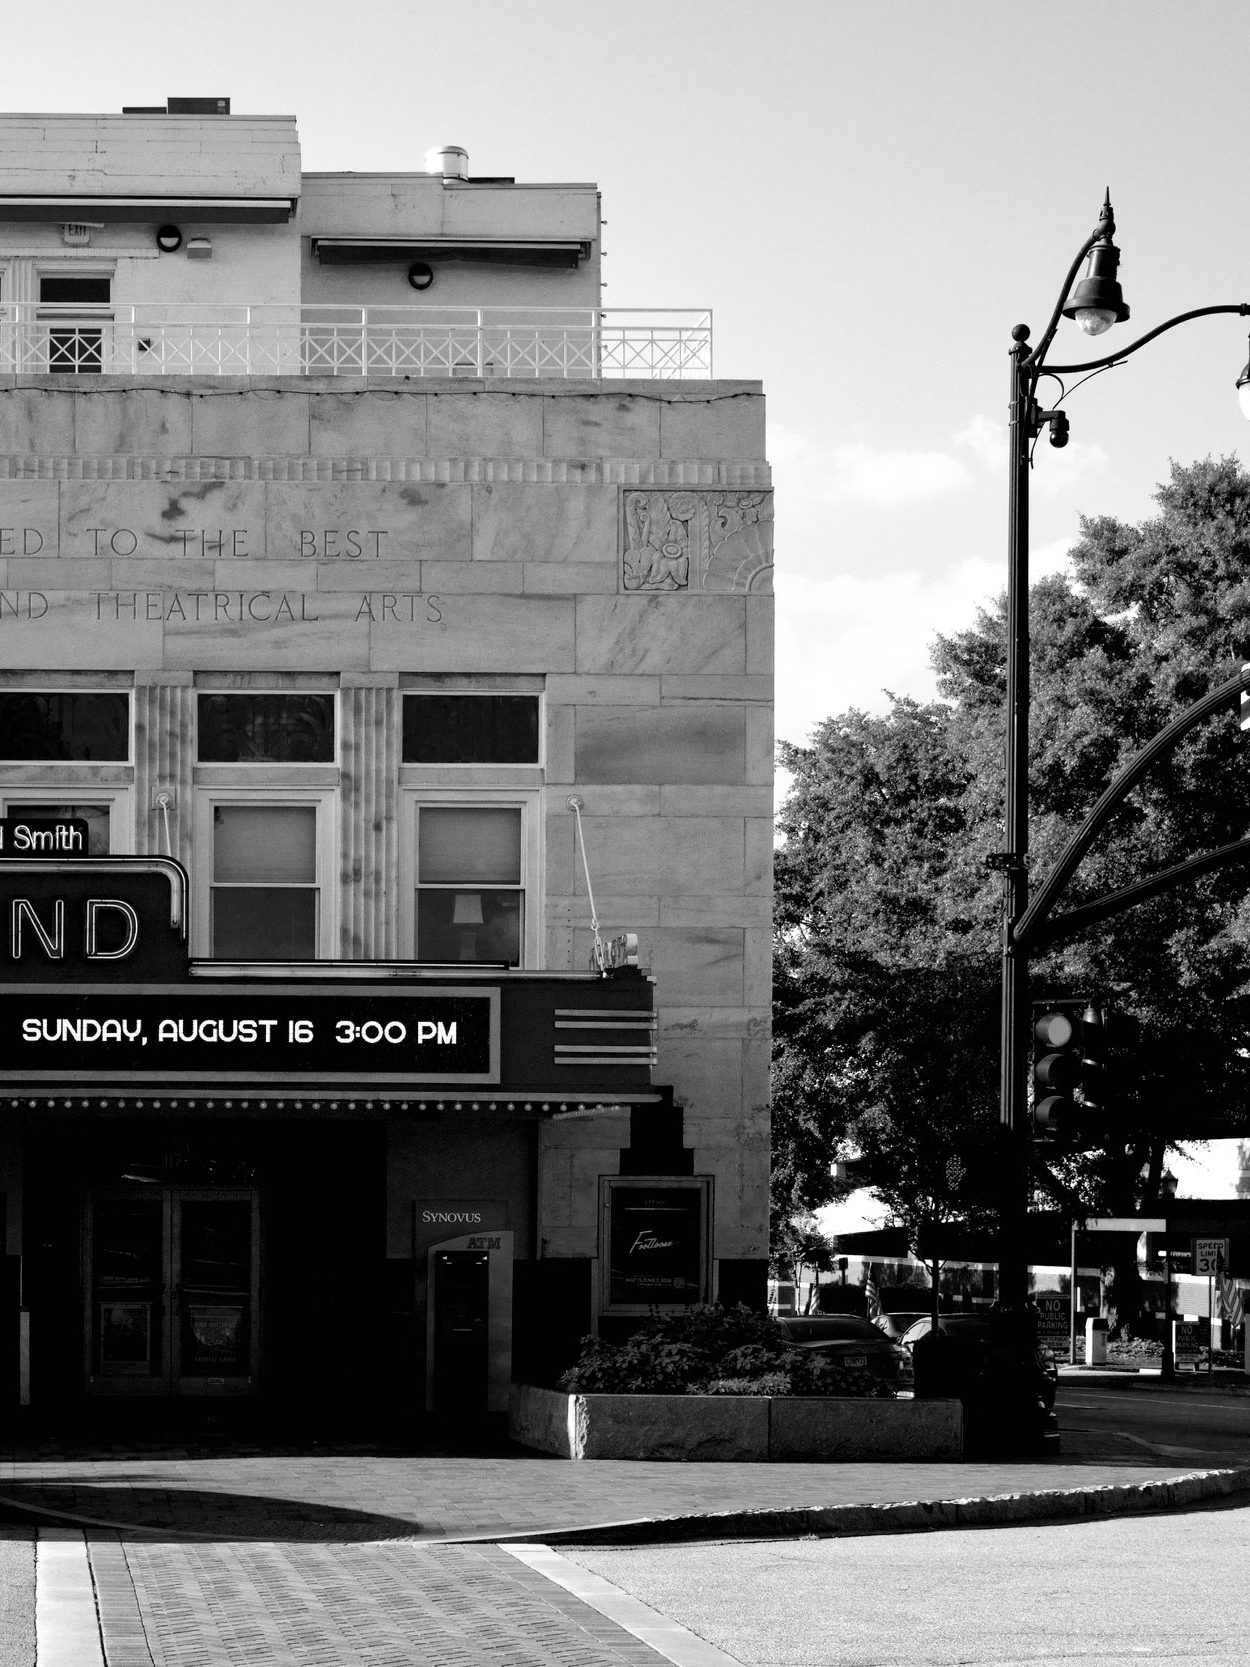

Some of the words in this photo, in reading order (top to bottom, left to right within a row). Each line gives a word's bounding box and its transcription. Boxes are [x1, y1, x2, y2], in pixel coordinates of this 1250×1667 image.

[68, 224, 87, 237] EXIT
[86, 528, 139, 557] TO
[175, 528, 249, 558] THE
[299, 529, 389, 559] BEST
[90, 592, 319, 622] THEATRICAL
[354, 593, 444, 623] ARTS
[13, 824, 83, 851] Smith
[22, 1018, 148, 1046] SUNDAY,
[158, 1019, 278, 1043] AUGUST
[288, 1020, 314, 1043] 16
[335, 1020, 407, 1044] 3:00
[417, 1021, 457, 1045] PM
[422, 1210, 482, 1223] SYNOVUS
[466, 1237, 501, 1250] ATM
[629, 1230, 673, 1254] Footloose
[1197, 1242, 1224, 1250] SPEED
[1200, 1250, 1216, 1258] LIMI
[1045, 1299, 1061, 1311] NO
[1039, 1312, 1066, 1321] PUBLIC
[1037, 1321, 1069, 1329] PARKING
[1181, 1325, 1193, 1335] NO
